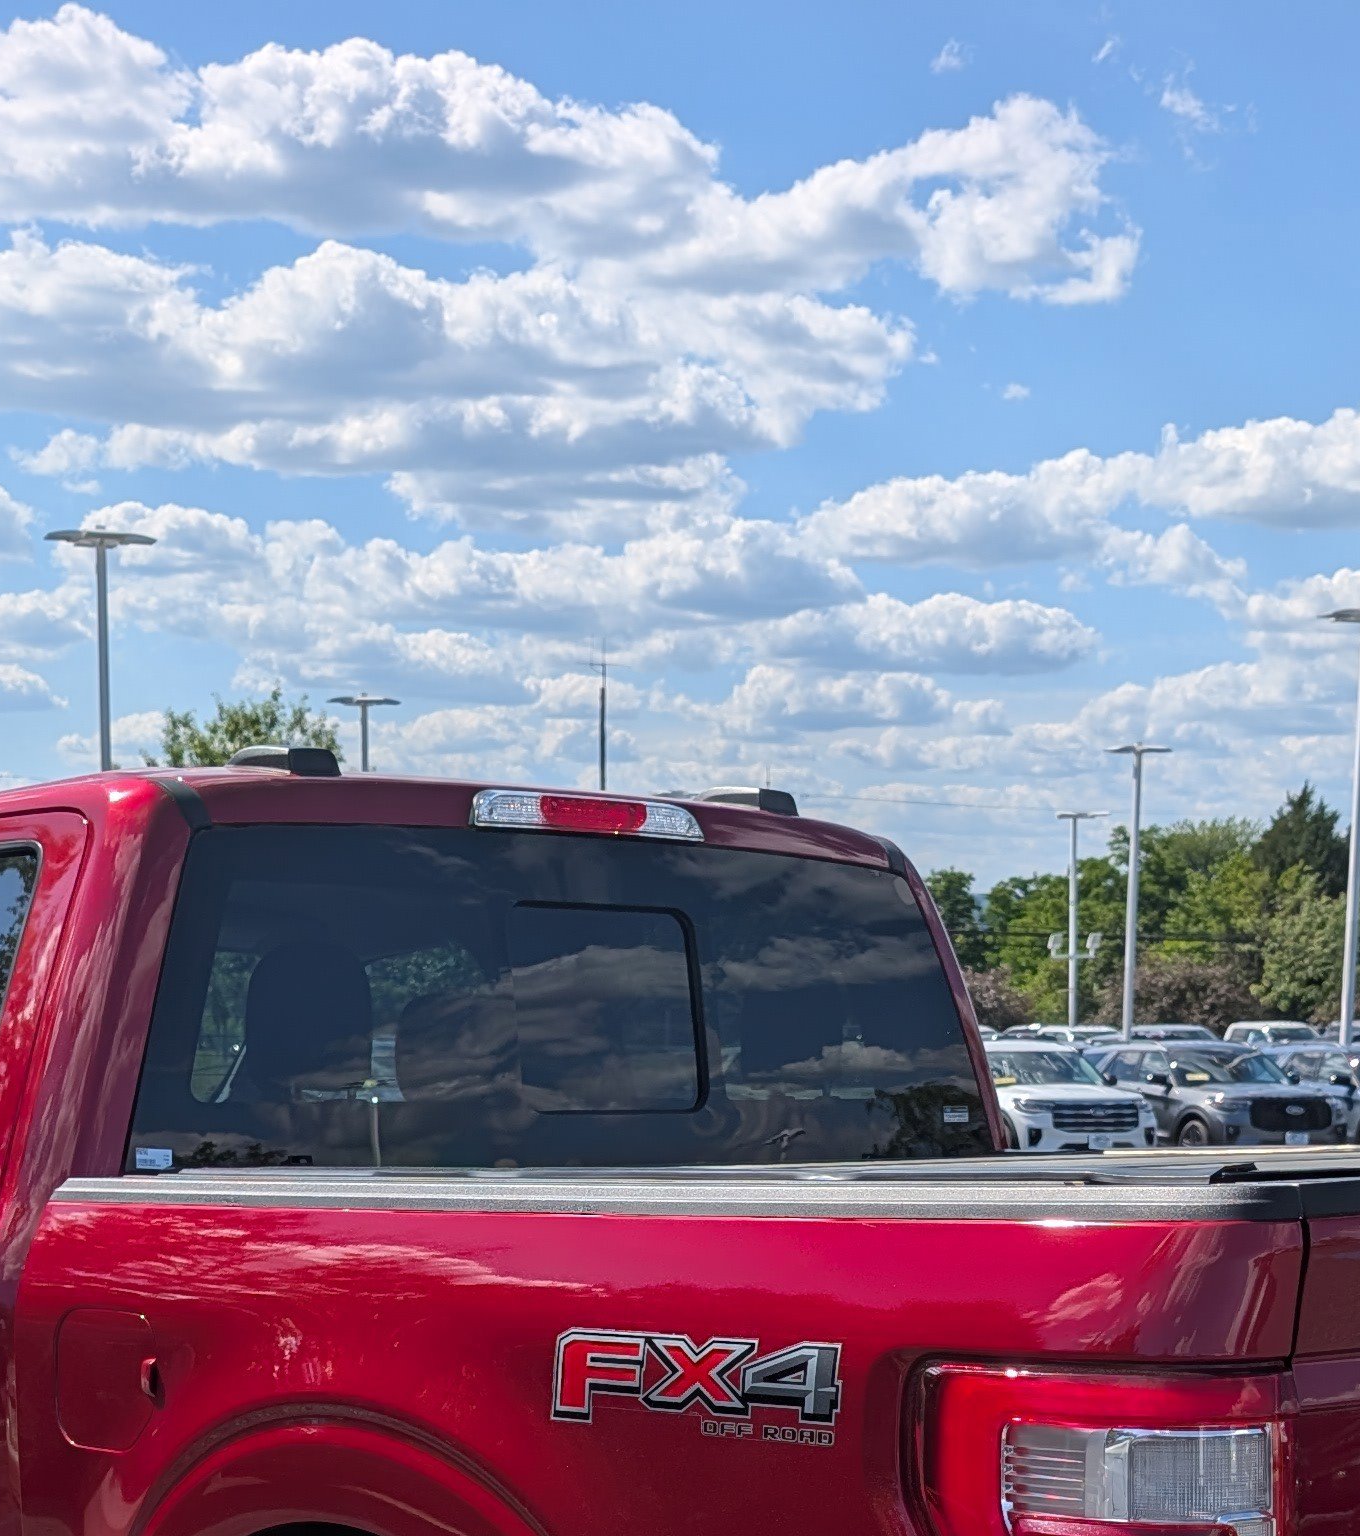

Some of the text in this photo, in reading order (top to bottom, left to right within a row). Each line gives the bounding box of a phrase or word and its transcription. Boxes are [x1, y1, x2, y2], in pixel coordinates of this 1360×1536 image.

[551, 1327, 843, 1425] FX4
[701, 1420, 836, 1446] OFF ROAD
